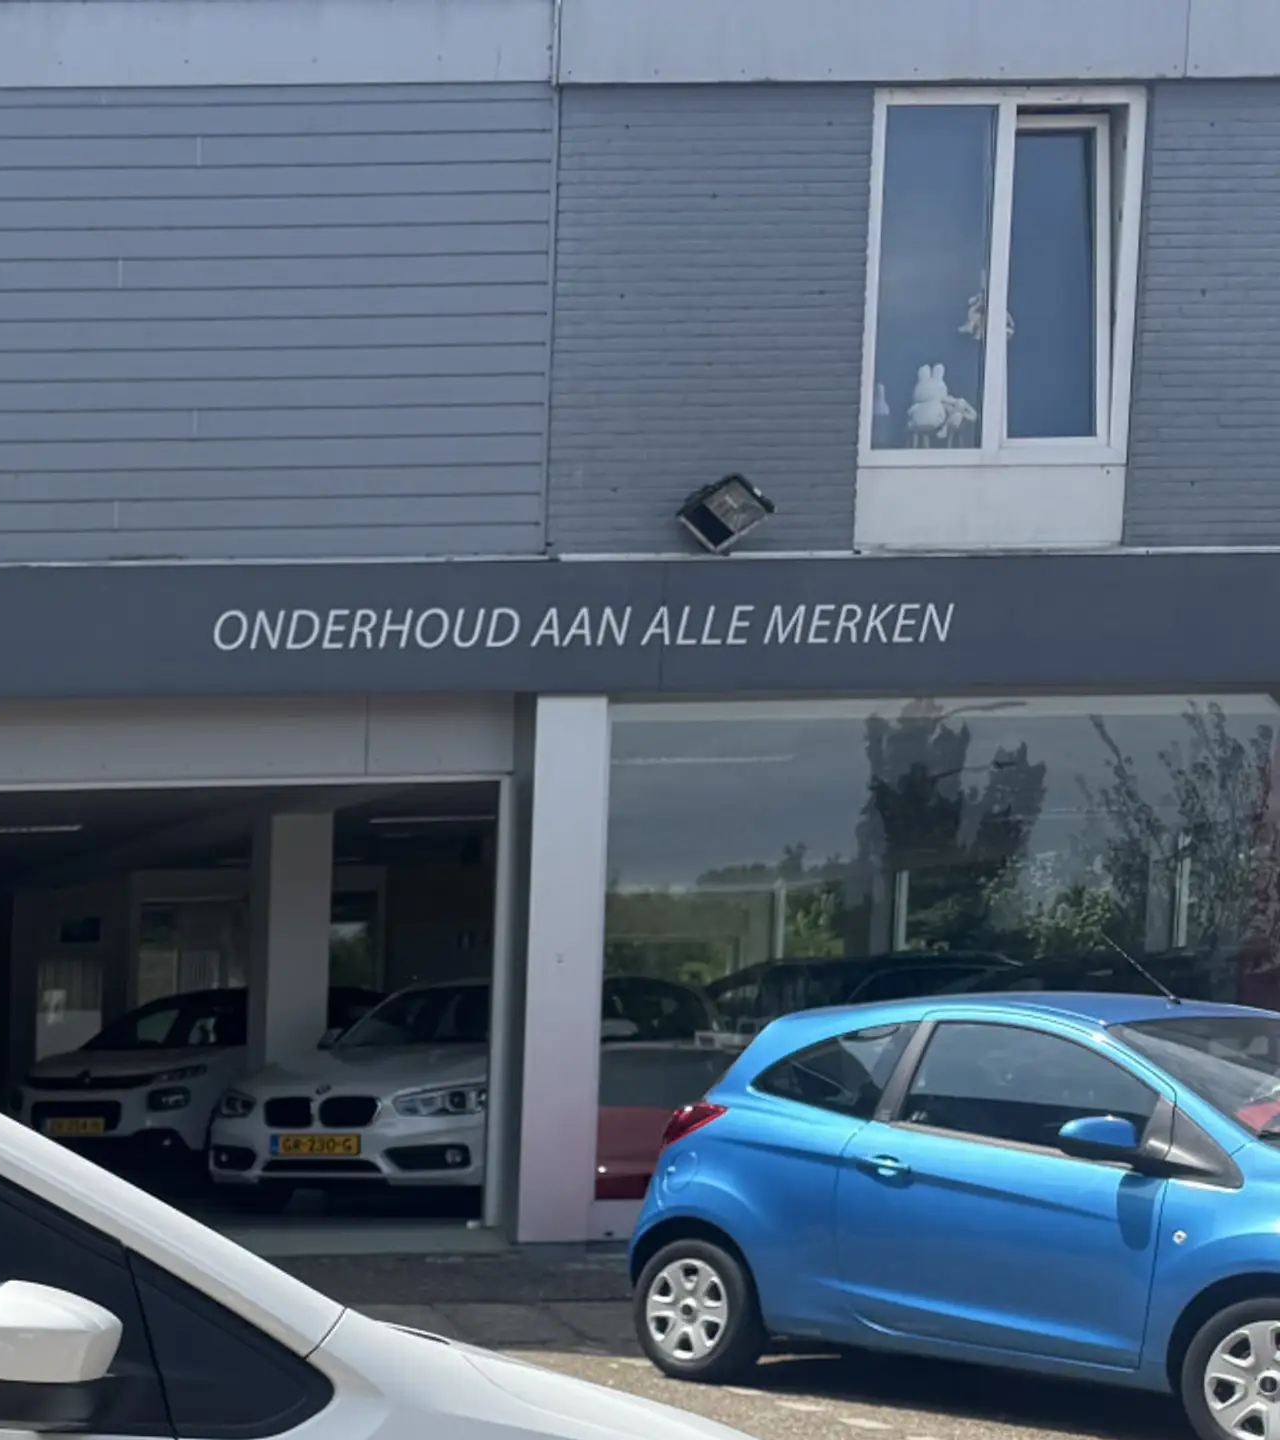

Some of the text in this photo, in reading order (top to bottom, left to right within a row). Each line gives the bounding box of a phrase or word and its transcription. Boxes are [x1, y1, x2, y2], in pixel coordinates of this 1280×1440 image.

[212, 602, 956, 651] ONDERHOUD AAN ALLE MERKEN
